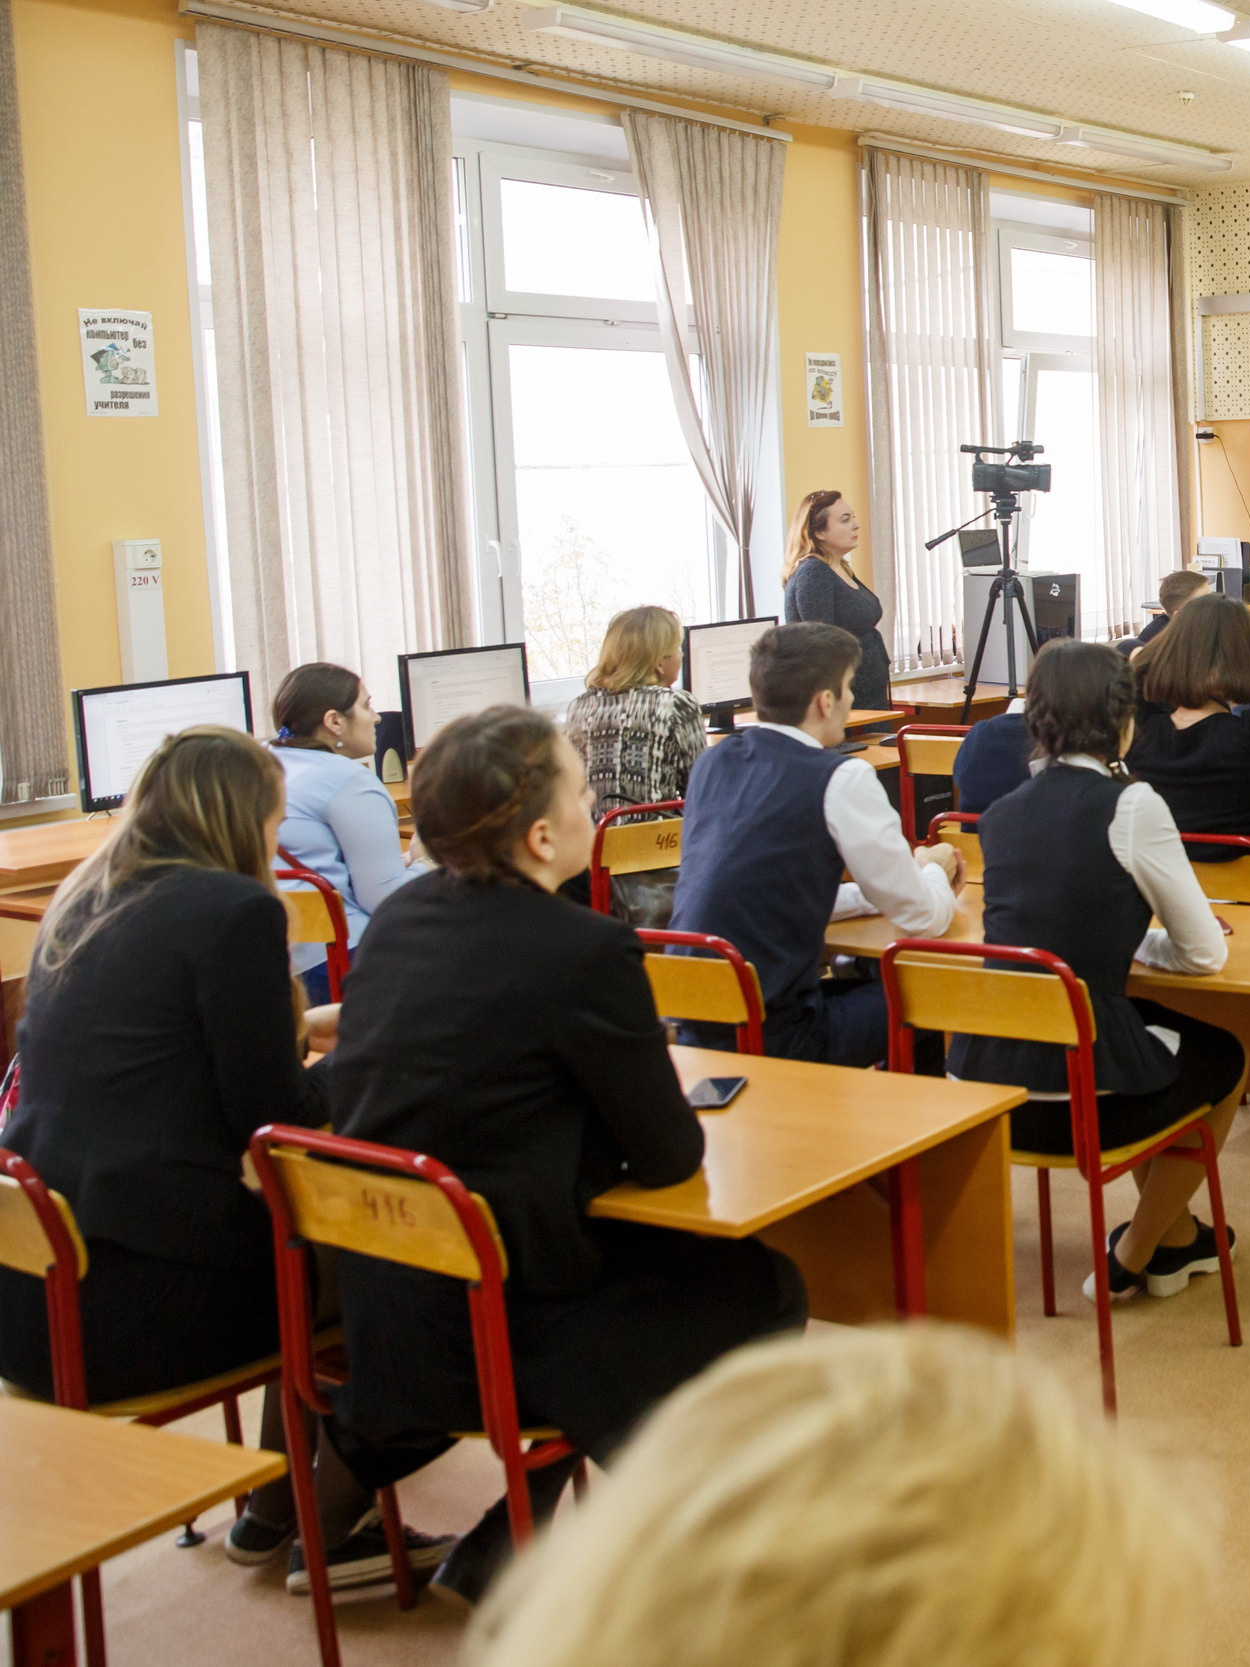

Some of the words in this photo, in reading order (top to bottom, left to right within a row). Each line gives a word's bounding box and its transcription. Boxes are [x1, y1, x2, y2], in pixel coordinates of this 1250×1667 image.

[83, 317, 98, 328] Не
[101, 317, 148, 330] включай
[86, 329, 130, 342] компьютер
[132, 337, 147, 349] без
[94, 401, 130, 410] учителя
[131, 576, 149, 586] 220
[151, 575, 160, 584] V
[655, 832, 678, 850] 416
[361, 1188, 417, 1228] 416
